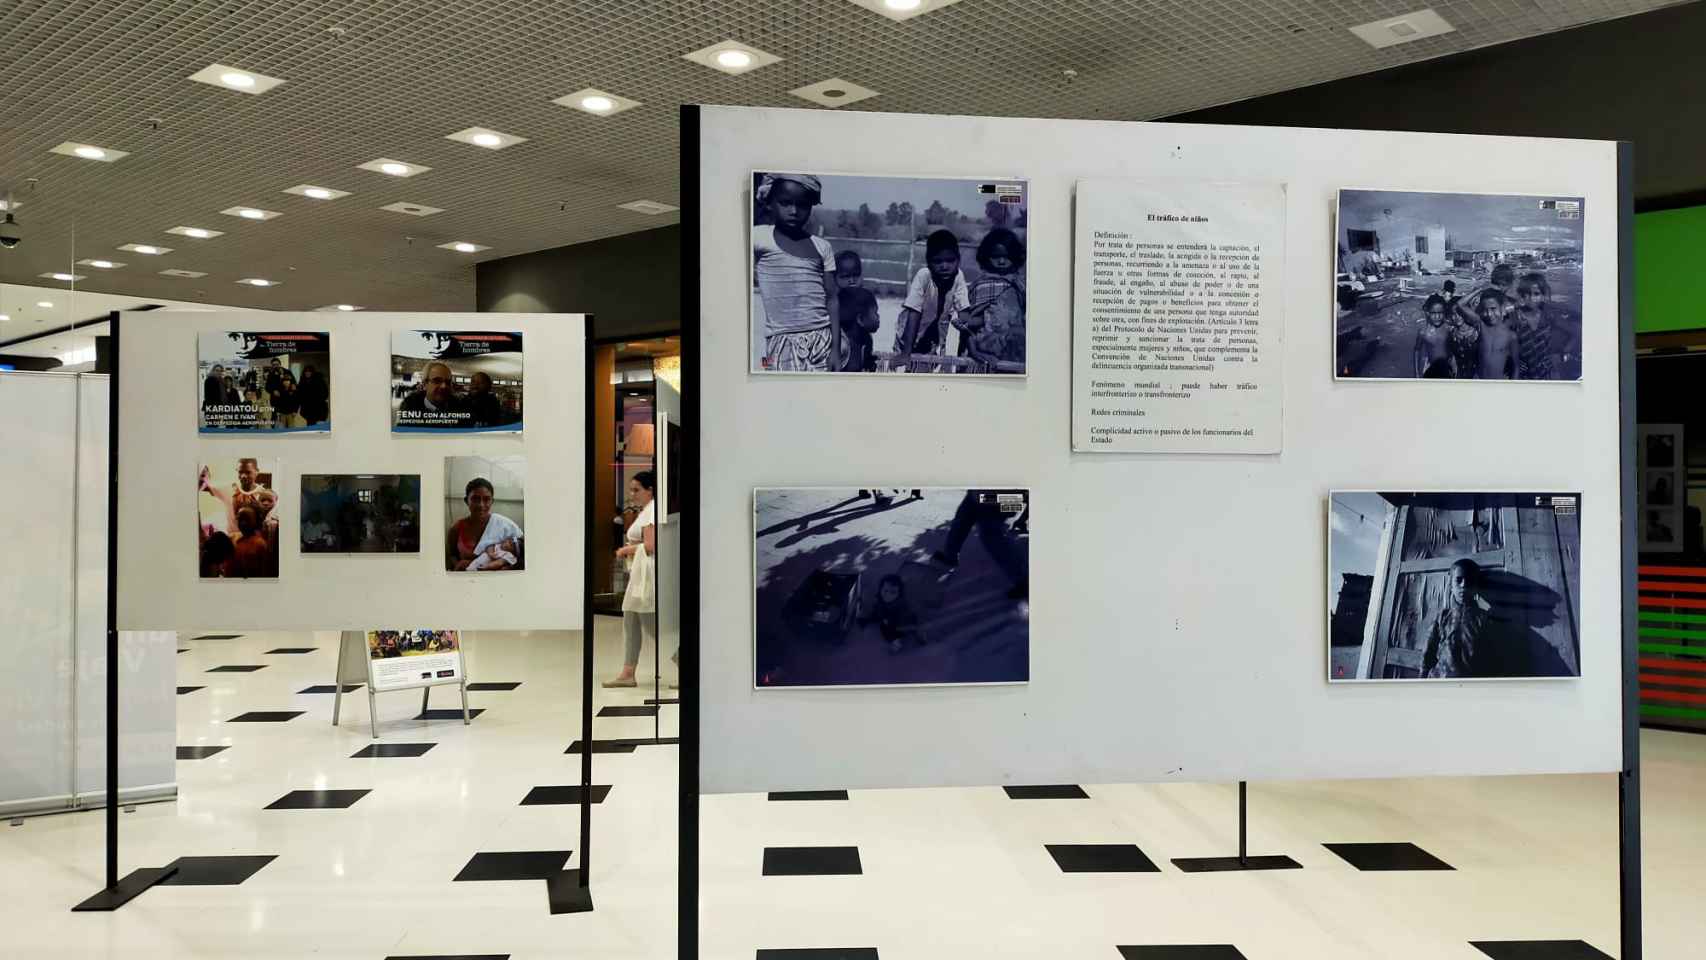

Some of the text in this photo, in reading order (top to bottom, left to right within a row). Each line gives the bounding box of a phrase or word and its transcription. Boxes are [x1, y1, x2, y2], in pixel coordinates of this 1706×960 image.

[1147, 213, 1208, 222] El tráfico de niños
[1094, 230, 1128, 238] Definición
[1093, 240, 1105, 248] Por
[1125, 241, 1133, 249] de
[1135, 243, 1164, 251] personas
[1093, 250, 1127, 260] transporte,
[1129, 250, 1136, 258] el
[1167, 251, 1174, 259] la
[1176, 251, 1201, 261] acogida
[1210, 252, 1216, 260] la
[1219, 252, 1249, 262] recepción
[1251, 253, 1259, 261] de
[1242, 262, 1251, 270] de
[1253, 262, 1259, 270] la
[1093, 269, 1116, 277] fuerza
[1126, 269, 1142, 277] otras
[1146, 270, 1169, 278] formas
[1172, 270, 1183, 278] de
[1219, 271, 1226, 279] al
[1119, 278, 1126, 286] al
[1159, 279, 1165, 287] al
[1169, 279, 1189, 287] abuso
[1204, 280, 1223, 290] poder
[1235, 280, 1243, 288] de
[1092, 287, 1122, 295] situación
[1138, 288, 1184, 296] vulnerabilidad
[1207, 289, 1214, 297] la
[1217, 289, 1250, 297] concesión
[1092, 296, 1126, 306] recepción
[1127, 297, 1136, 305] de
[1139, 299, 1158, 307] pagos
[1170, 298, 1203, 306] beneficios
[1207, 300, 1221, 308] para
[1252, 299, 1259, 307] el
[1092, 306, 1141, 314] consentimiento
[1143, 307, 1151, 315] de
[1167, 309, 1193, 317] persona
[1208, 308, 1227, 318] tenga
[1228, 308, 1259, 316] autoridad
[1092, 315, 1110, 323] sobre
[1141, 316, 1157, 324] fines
[1157, 316, 1166, 324] de
[1091, 324, 1099, 334] a)
[1113, 325, 1146, 333] Protocolo
[1146, 325, 1155, 333] de
[1156, 326, 1187, 334] Naciones
[1189, 326, 1212, 334] Unidas
[1213, 328, 1228, 336] para
[1091, 334, 1118, 344] reprimir
[1125, 336, 1130, 344] y
[1139, 335, 1169, 343] sancionar
[1176, 335, 1183, 343] la
[1091, 343, 1137, 353] especialmente
[1138, 344, 1164, 353] mujeres
[1193, 346, 1206, 354] que
[1207, 344, 1250, 354] complementa
[1251, 345, 1258, 353] la
[1091, 352, 1130, 361] Convención
[1138, 353, 1147, 361] de
[1154, 353, 1184, 361] Naciones
[1192, 354, 1215, 362] Unidas
[1223, 354, 1243, 362] contra
[1091, 362, 1132, 370] delincuencia
[1132, 362, 1168, 372] organizada
[1091, 380, 1125, 388] Fenómeno
[1180, 381, 1200, 391] puede
[1209, 381, 1227, 389] haber
[1091, 389, 1138, 398] interfronterizo
[1143, 390, 1190, 398] transfronterizo
[205, 404, 258, 412] KARDIATOU
[1091, 408, 1145, 416] Redes criminales
[396, 410, 422, 418] FENU
[1090, 426, 1131, 436] Complicidad
[1159, 427, 1181, 436] pasivo
[1181, 427, 1190, 435] de
[1191, 427, 1201, 435] los
[1202, 427, 1241, 435] funcionarios
[1090, 435, 1112, 443] Estado
